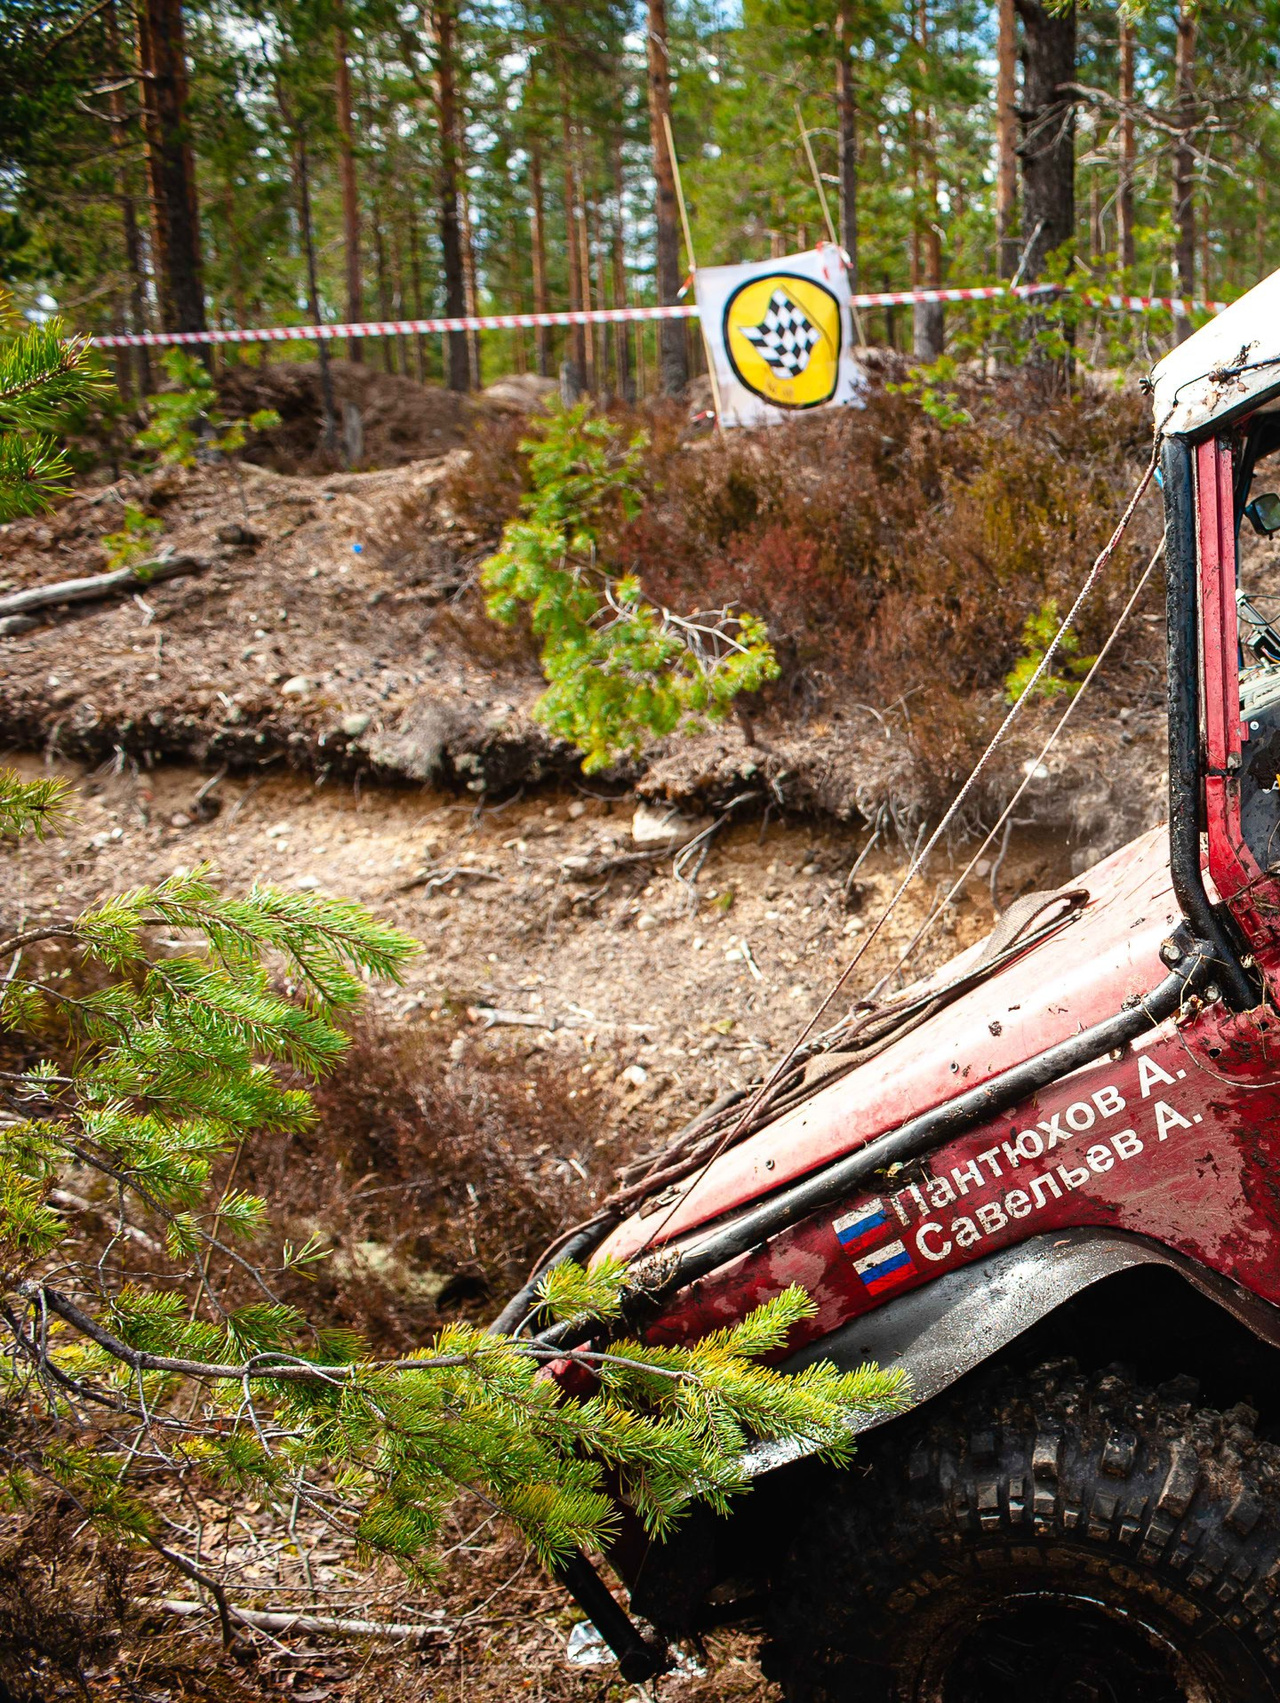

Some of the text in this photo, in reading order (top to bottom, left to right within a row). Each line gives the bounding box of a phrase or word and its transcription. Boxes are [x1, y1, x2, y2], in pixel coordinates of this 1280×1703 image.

[890, 1054, 1188, 1227] Пантюхов А.
[915, 1100, 1204, 1261] Савельев А.
